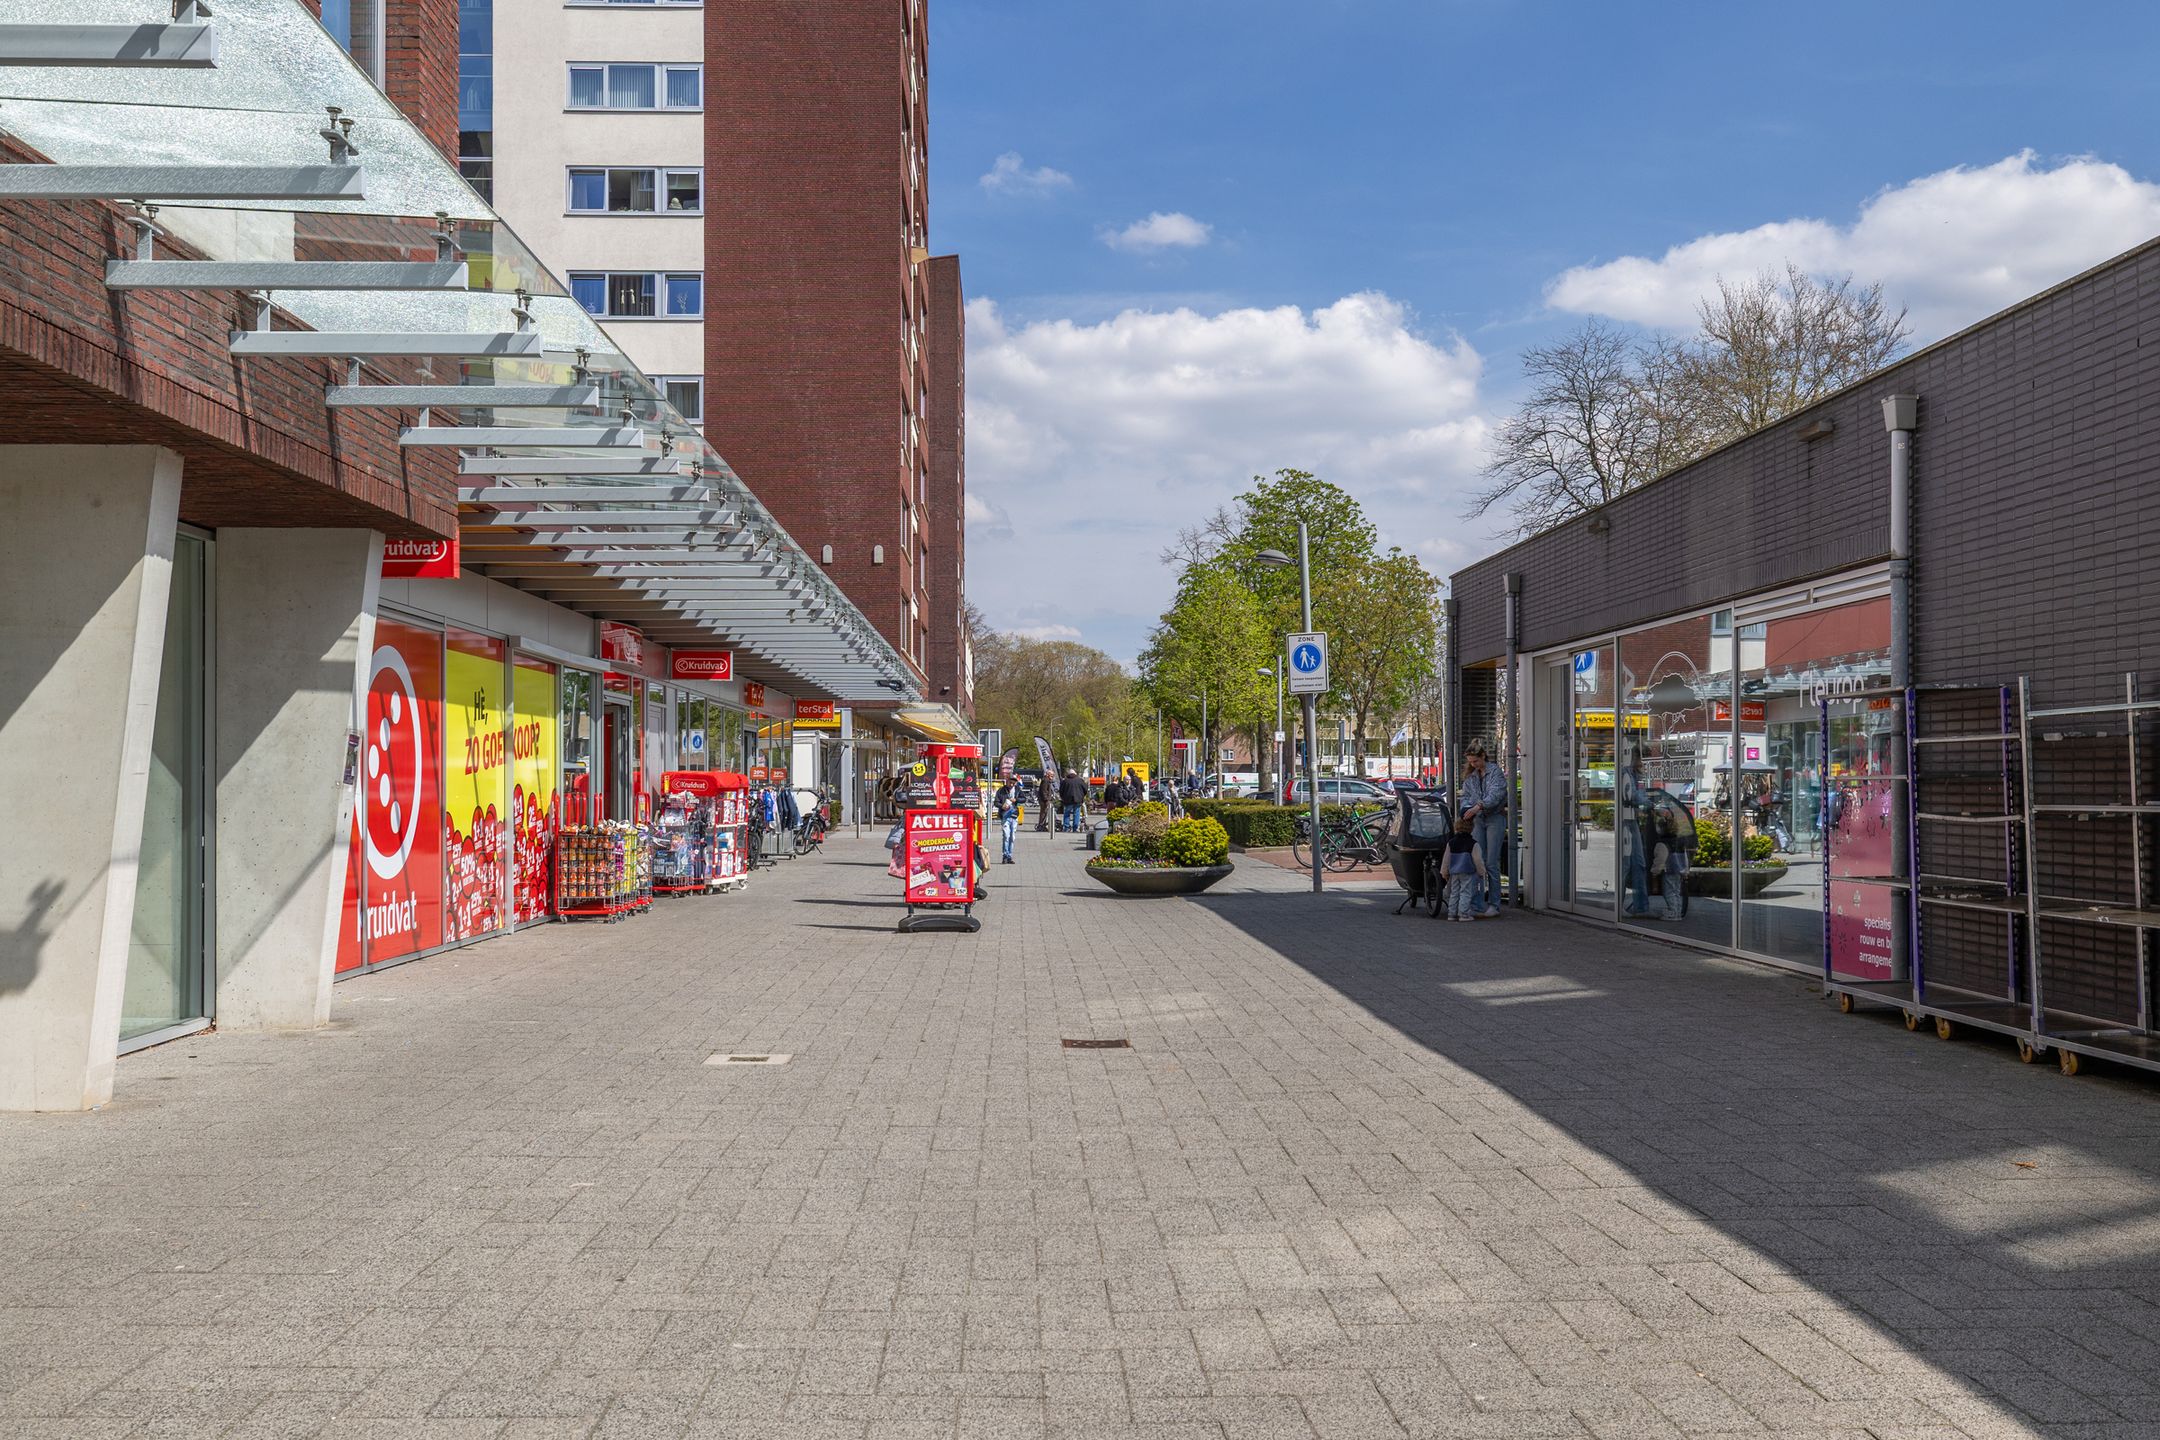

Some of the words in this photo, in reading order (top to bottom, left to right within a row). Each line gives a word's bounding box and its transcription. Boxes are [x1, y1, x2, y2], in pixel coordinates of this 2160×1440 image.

[688, 660, 725, 671] Kruidvat
[798, 704, 831, 714] terStal
[464, 736, 480, 776] ZO
[681, 781, 706, 789] Kruidvat
[912, 814, 964, 829] ACTIE!
[917, 837, 955, 847] MOEDERDAG
[920, 843, 961, 853] MEEPAKKERS
[461, 852, 476, 877] 50%
[458, 901, 472, 932] 1+1
[1860, 934, 1877, 947] rouw
[1876, 936, 1886, 947] en
